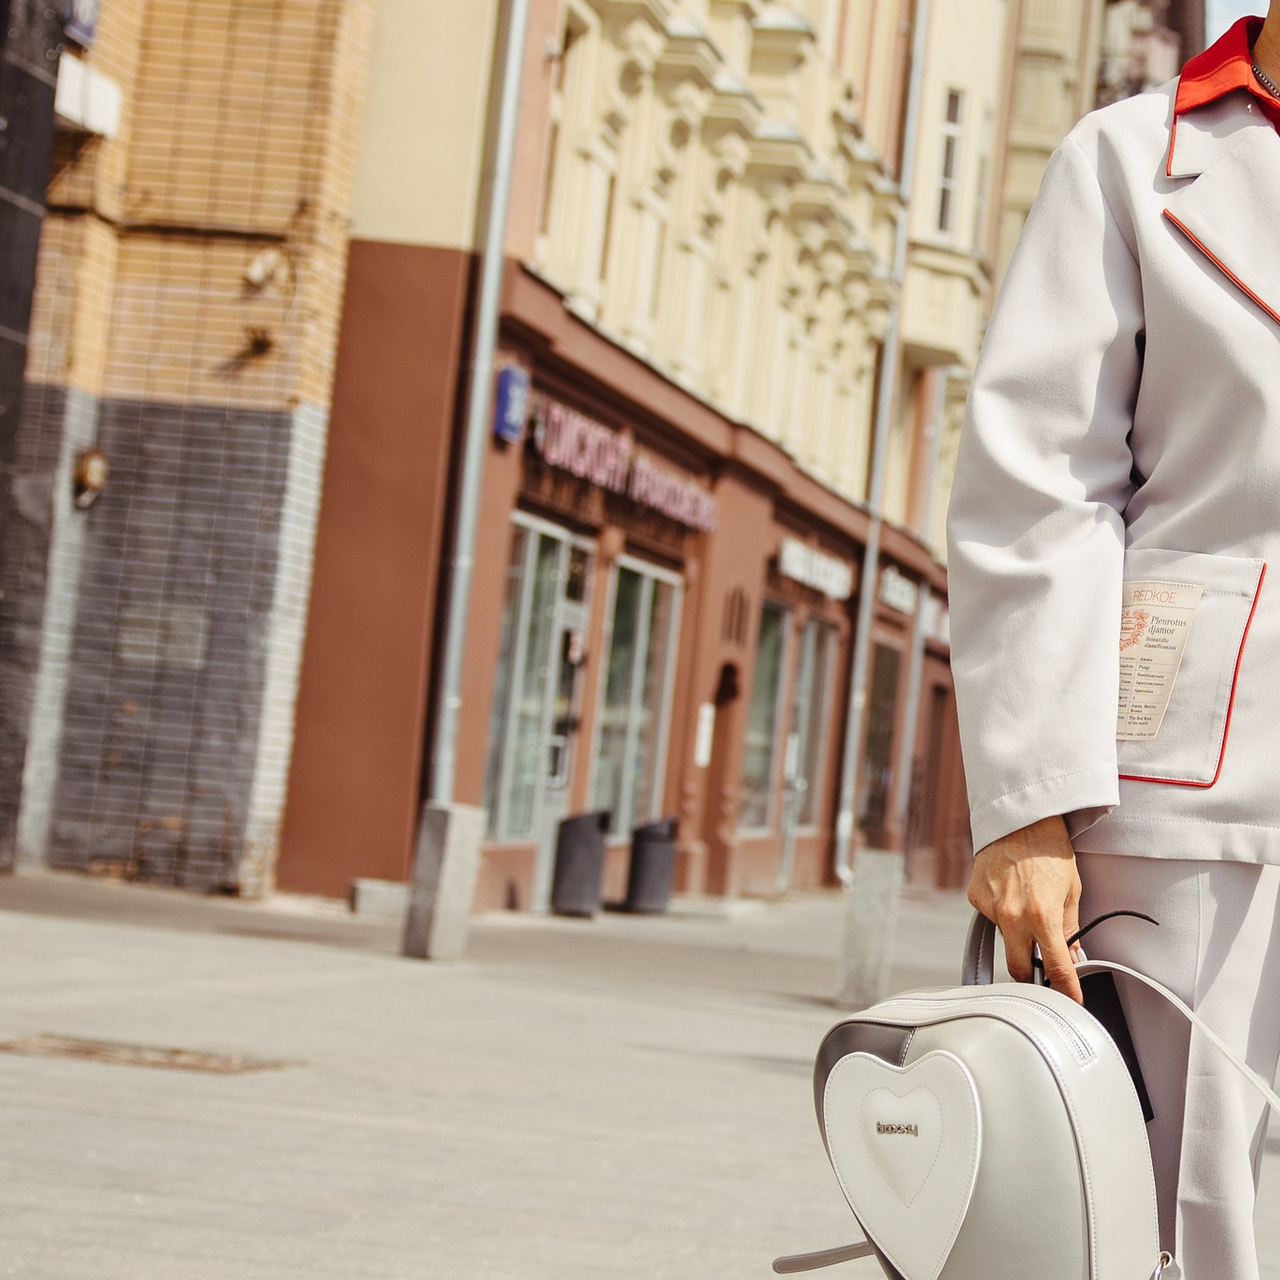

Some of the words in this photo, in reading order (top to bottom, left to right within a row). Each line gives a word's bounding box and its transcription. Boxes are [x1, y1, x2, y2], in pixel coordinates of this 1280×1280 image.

[1133, 589, 1177, 603] REDKOE
[1151, 616, 1187, 627] Pleurotus
[1148, 624, 1175, 635] djamor
